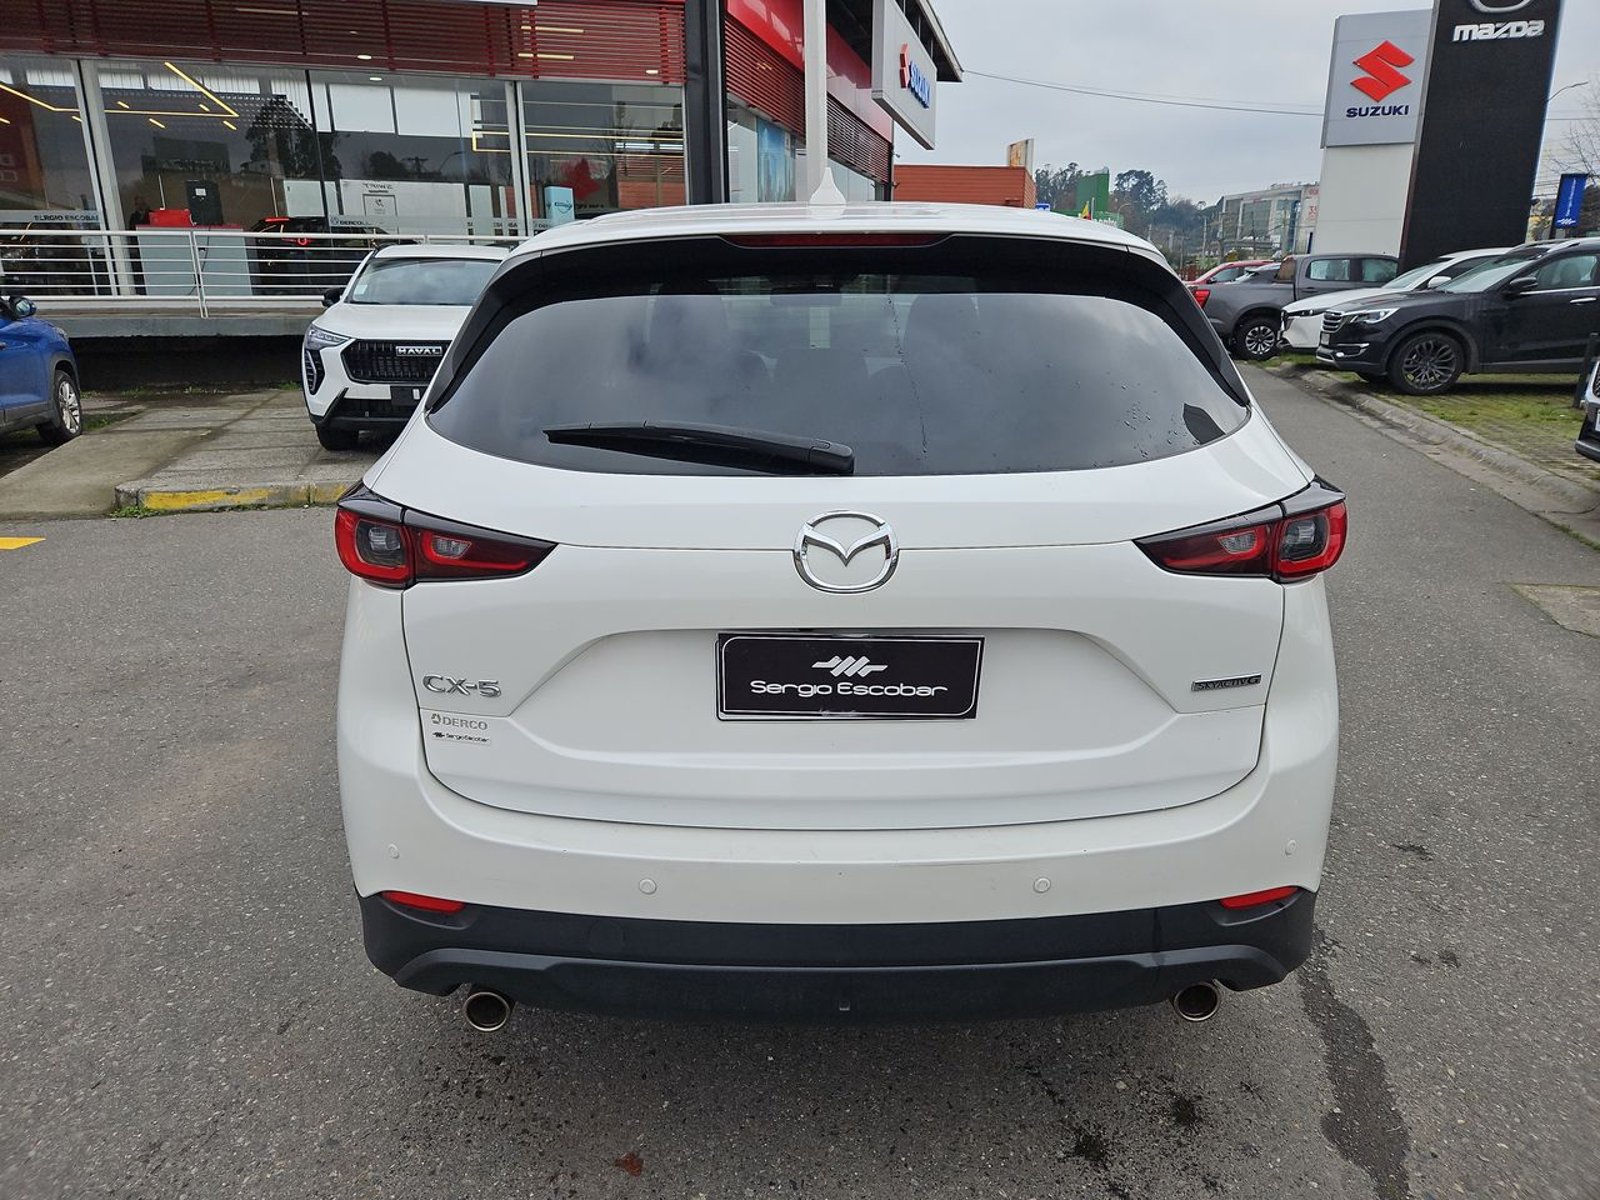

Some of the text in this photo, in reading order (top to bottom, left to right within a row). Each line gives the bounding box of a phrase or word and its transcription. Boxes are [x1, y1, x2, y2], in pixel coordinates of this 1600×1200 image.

[1346, 105, 1409, 117] SUZUKI
[397, 347, 442, 356] HAVAL
[423, 674, 501, 697] CX-5
[750, 681, 948, 698] Sergio Escobar
[443, 717, 488, 730] DERCO
